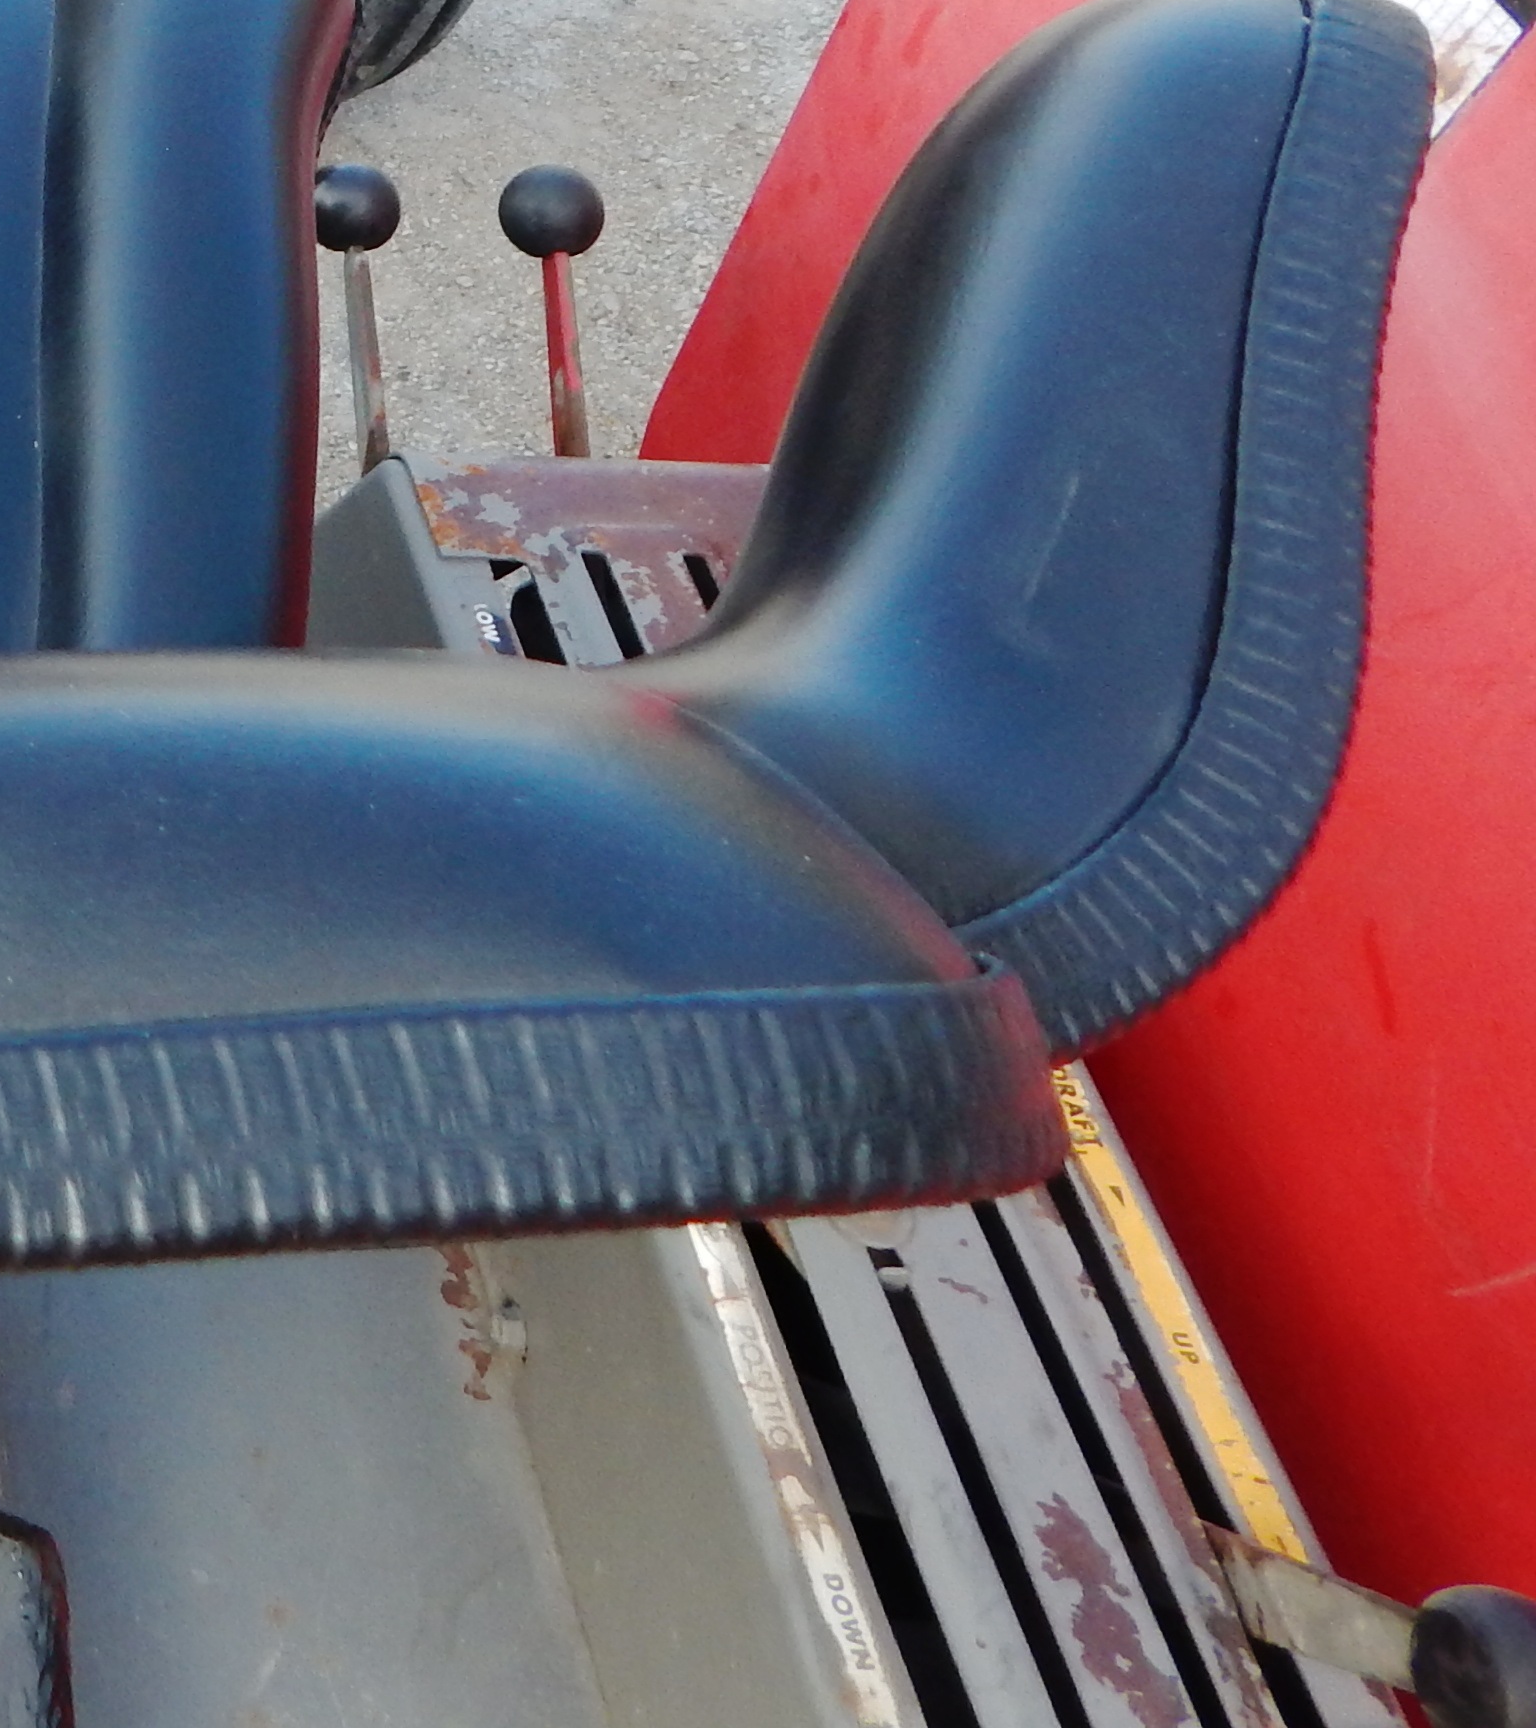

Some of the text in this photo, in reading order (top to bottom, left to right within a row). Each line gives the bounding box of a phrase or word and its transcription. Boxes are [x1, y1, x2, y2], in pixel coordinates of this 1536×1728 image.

[473, 603, 501, 643] LOW
[1050, 1067, 1103, 1148] DRAFT
[1172, 1331, 1200, 1366] UP
[823, 1573, 876, 1673] DOWN
